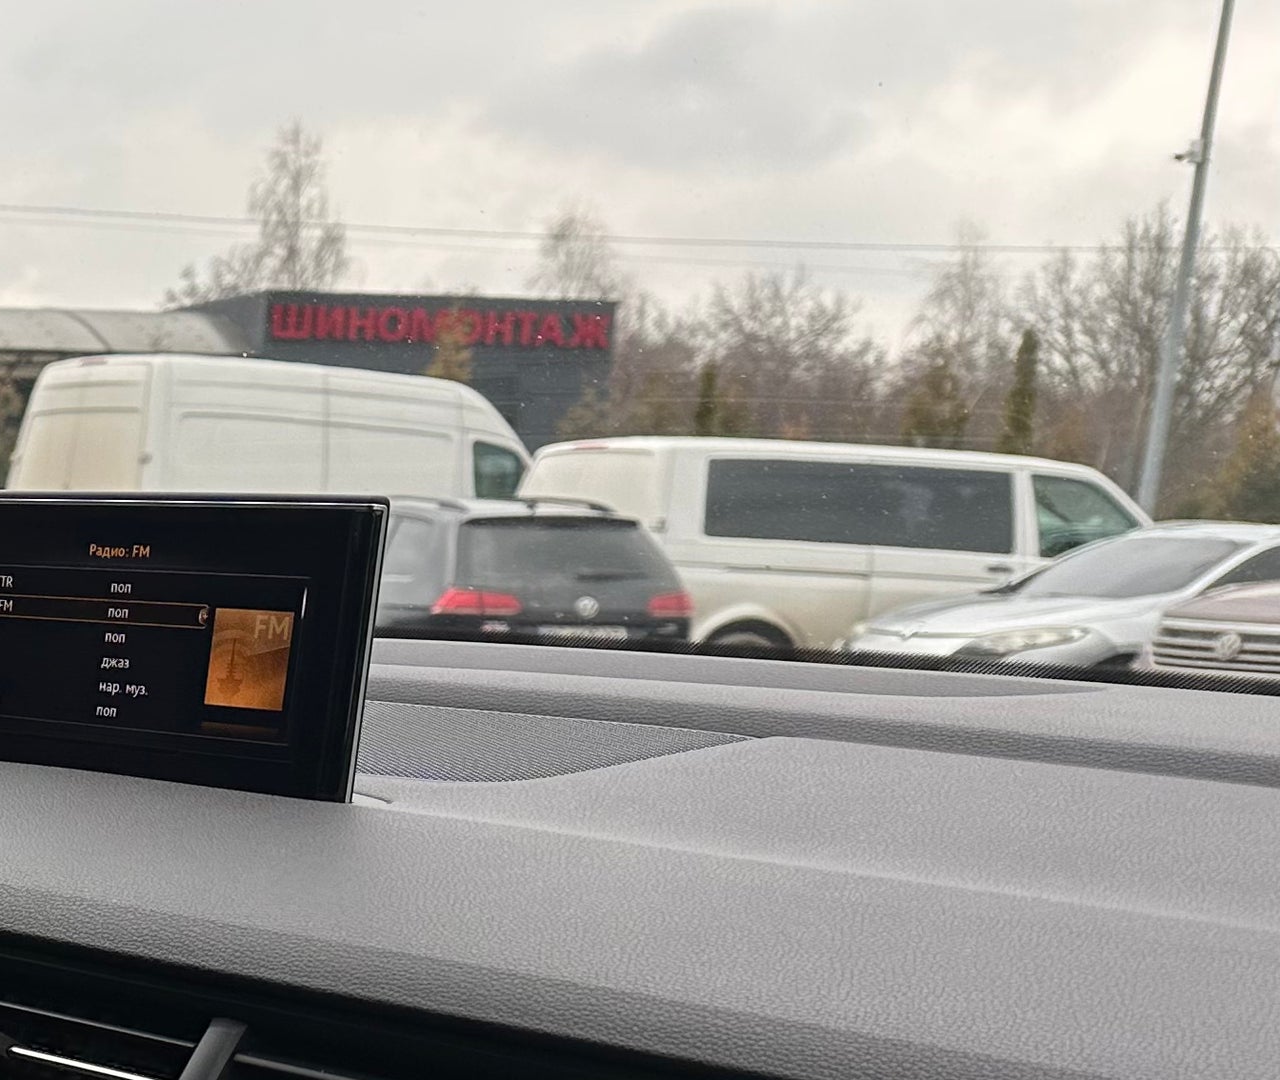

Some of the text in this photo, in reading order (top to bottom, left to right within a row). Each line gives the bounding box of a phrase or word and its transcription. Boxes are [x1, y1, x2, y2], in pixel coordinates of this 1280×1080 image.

[271, 304, 611, 348] ШИНОМОНТАЖ
[89, 544, 150, 559] Радио: FM
[111, 583, 131, 594] поп
[108, 607, 128, 619] поп
[253, 616, 290, 642] FM
[105, 632, 125, 644] поп
[101, 657, 129, 670] джаз
[99, 682, 148, 697] нар. муз.
[96, 706, 117, 718] поп
